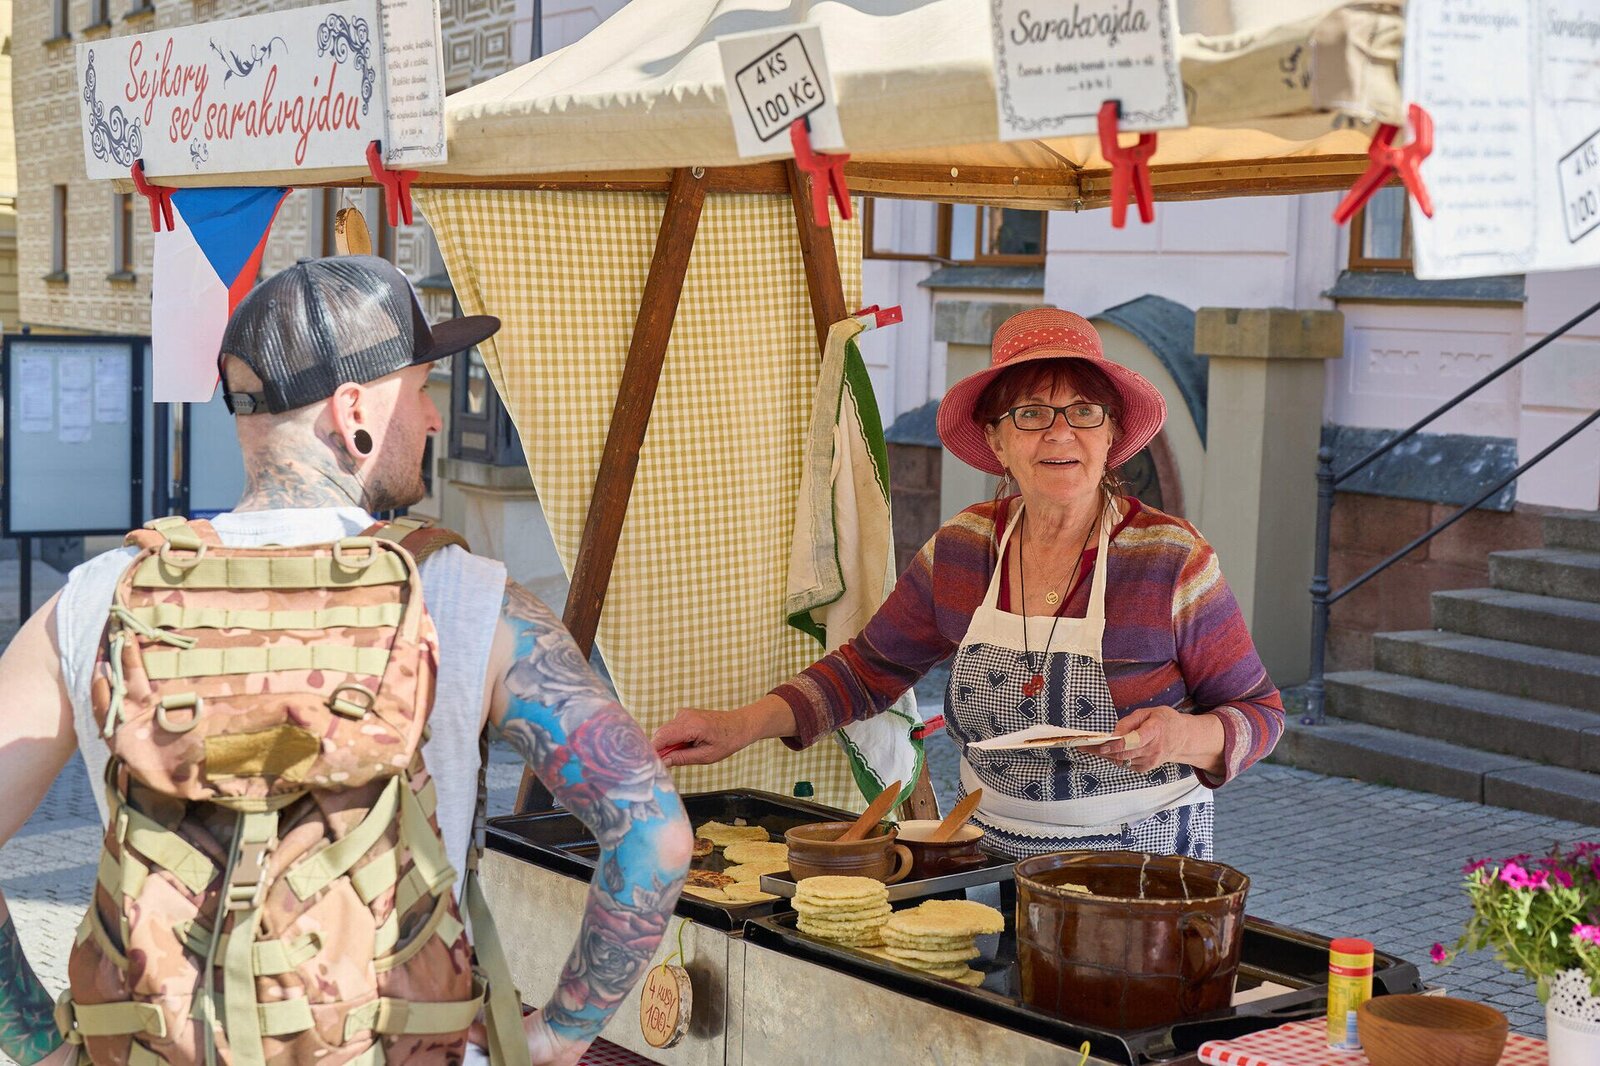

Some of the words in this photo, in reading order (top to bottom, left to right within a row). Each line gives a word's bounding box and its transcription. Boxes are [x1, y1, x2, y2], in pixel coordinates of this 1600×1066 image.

[1011, 0, 1149, 47] Sarakvajda
[125, 37, 209, 126] Sejkory
[756, 65, 767, 85] 4
[765, 52, 787, 78] KS
[169, 106, 194, 144] se
[204, 62, 360, 166] sarakvajdou
[756, 94, 789, 127] 100
[1570, 189, 1598, 227] 100
[649, 974, 656, 1000] 4
